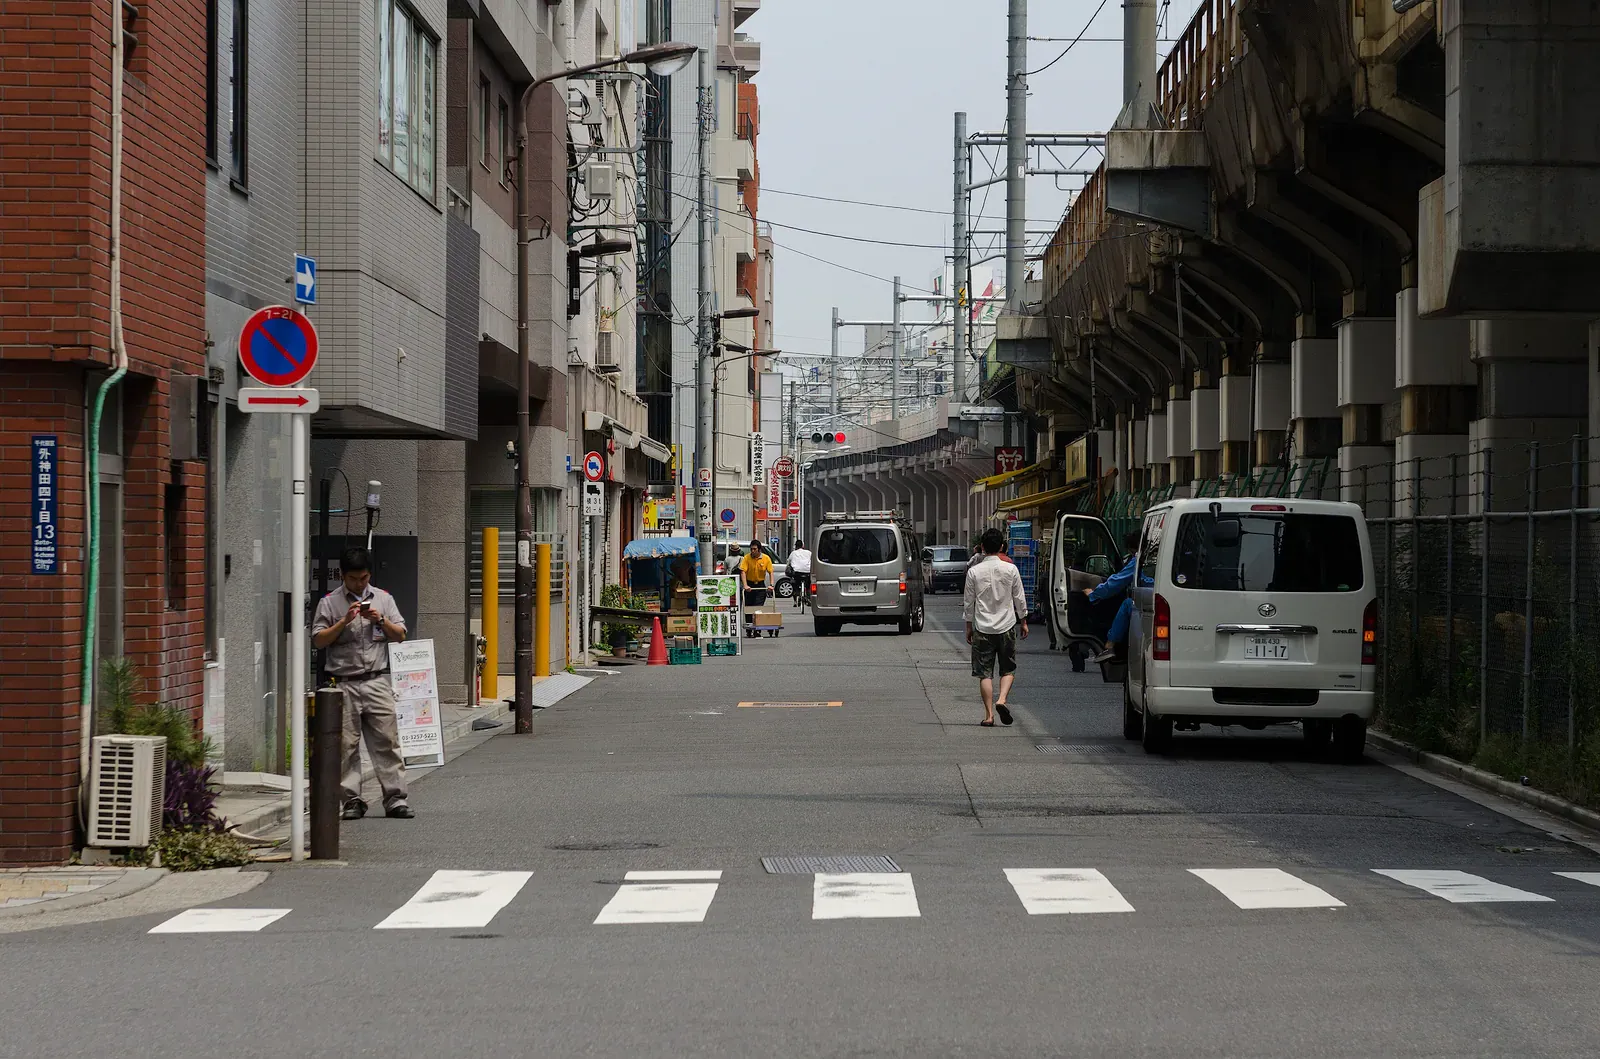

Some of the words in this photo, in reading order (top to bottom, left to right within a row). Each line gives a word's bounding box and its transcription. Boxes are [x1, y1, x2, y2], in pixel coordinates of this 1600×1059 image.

[265, 310, 293, 320] 7-21
[38, 448, 51, 523] 外神田四丁目
[35, 525, 54, 539] 13
[1255, 645, 1287, 657] 11-17
